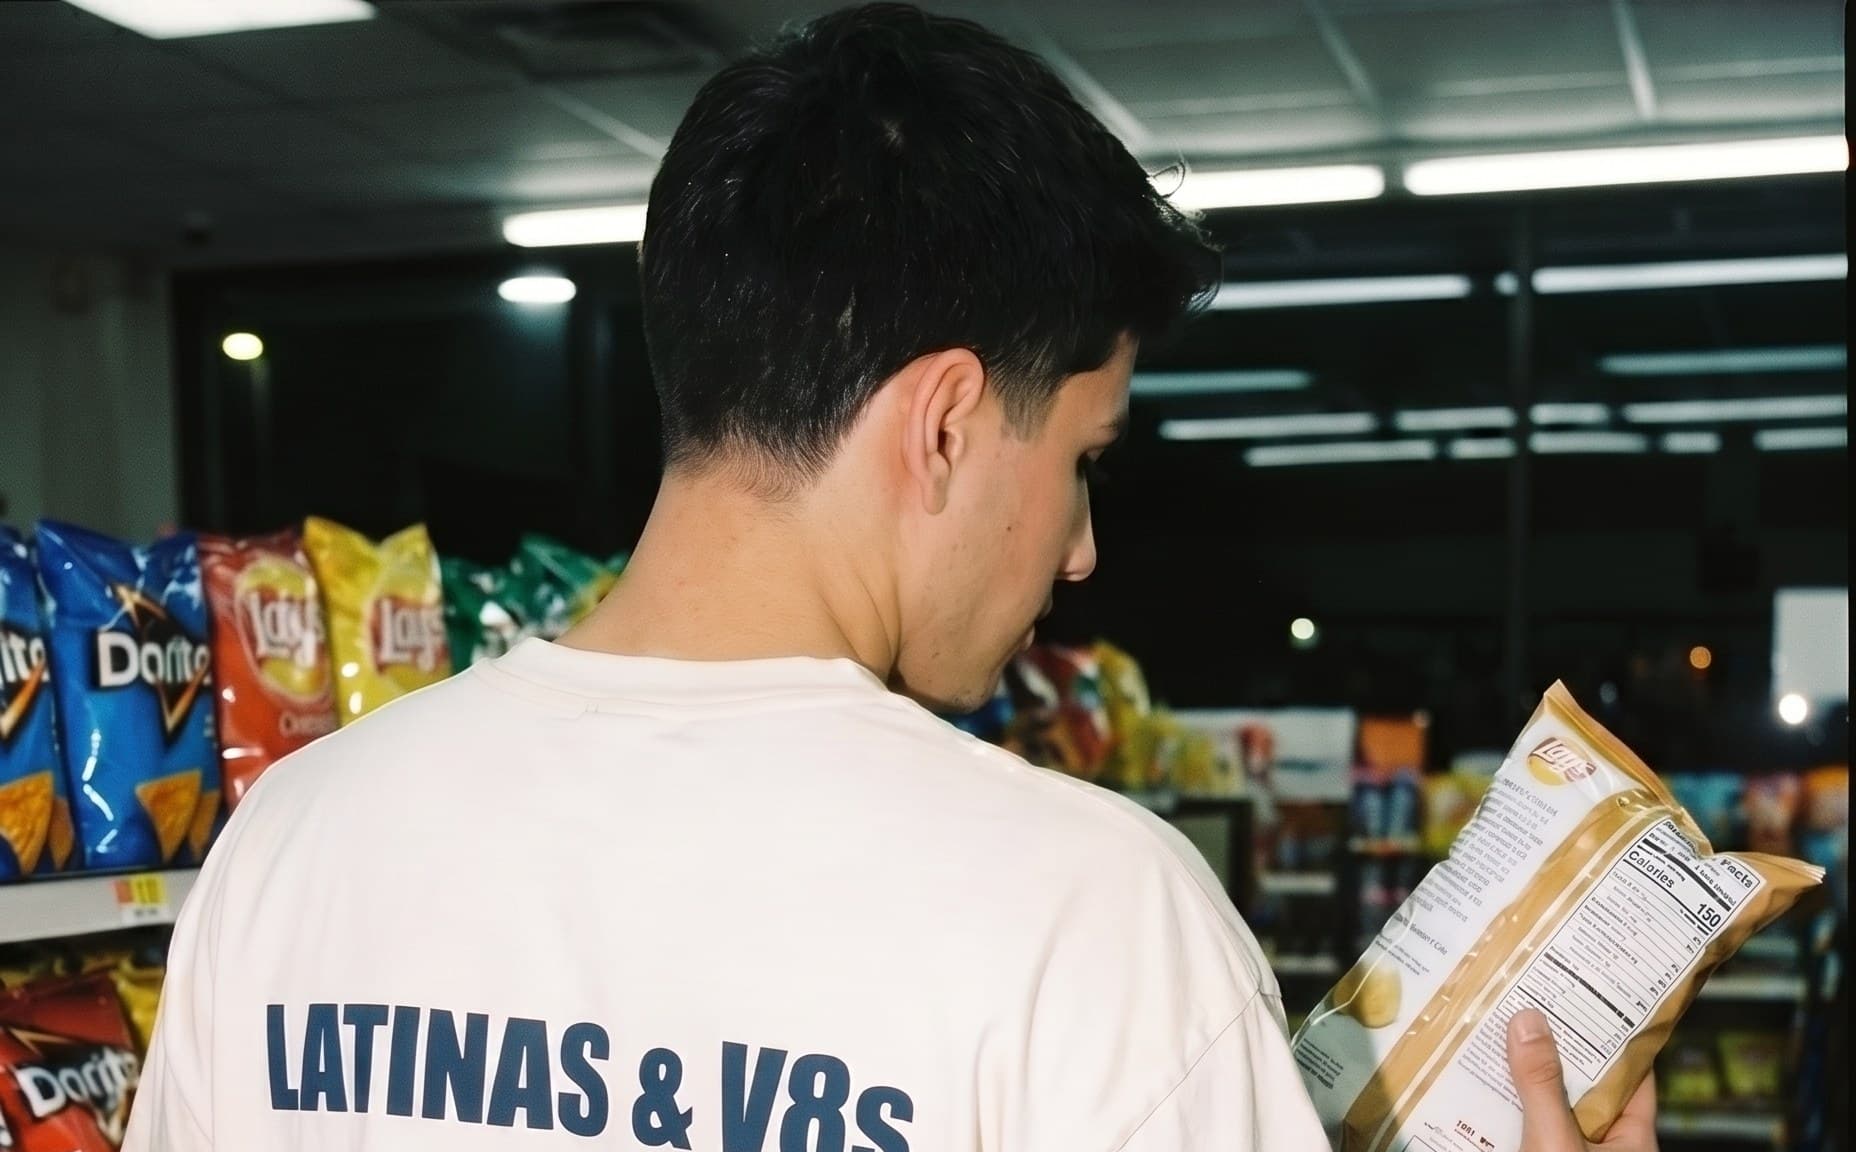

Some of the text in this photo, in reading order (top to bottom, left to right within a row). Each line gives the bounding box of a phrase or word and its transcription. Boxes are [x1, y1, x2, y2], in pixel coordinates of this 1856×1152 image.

[97, 630, 211, 687] Dorito
[1629, 850, 1675, 889] Calories
[1696, 903, 1722, 928] 150
[15, 1049, 139, 1118] Dorito
[266, 1003, 610, 1137] LATINAS
[632, 1047, 693, 1150] &
